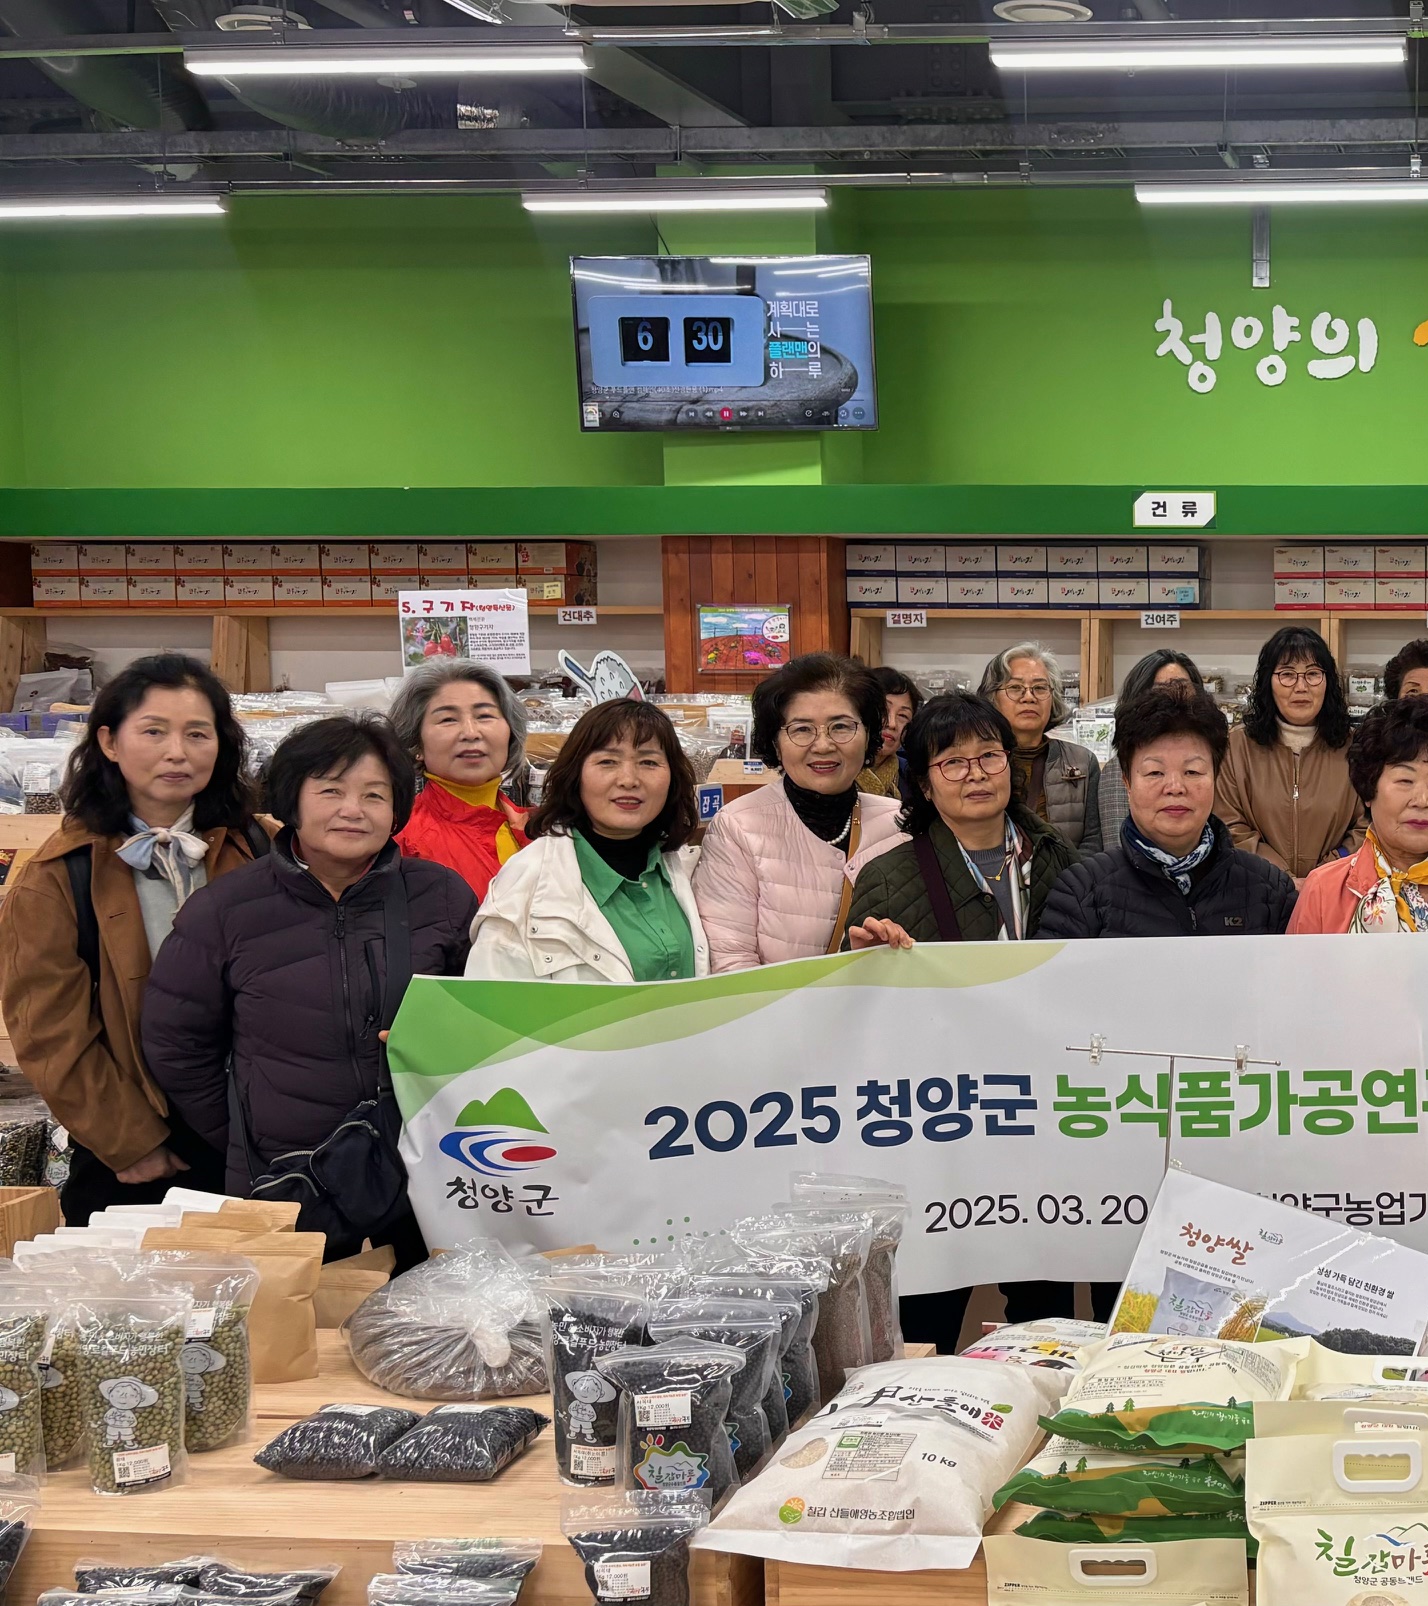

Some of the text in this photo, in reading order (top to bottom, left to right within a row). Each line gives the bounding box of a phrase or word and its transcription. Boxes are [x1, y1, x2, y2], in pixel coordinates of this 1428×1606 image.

[767, 301, 819, 318] 계획대로
[637, 321, 723, 350] 6 30
[768, 341, 820, 359] 플랜맨의
[1154, 300, 1378, 393] 청양의
[402, 601, 416, 614] 5.
[562, 610, 594, 622] 건대추
[891, 612, 924, 625] 결명자
[1144, 613, 1178, 626] 건여주
[702, 794, 720, 813] 잡곡
[1224, 916, 1243, 927] K2
[645, 1085, 841, 1161] 2025
[857, 1074, 1037, 1148] 청양군
[445, 1175, 560, 1217] 청양군
[1179, 1222, 1255, 1266] 청양쌀
[1332, 1271, 1347, 1284] 가득
[1348, 1276, 1363, 1289] 담긴
[1363, 1282, 1386, 1297] 친환경
[1386, 1290, 1395, 1300] 쌀
[921, 1452, 957, 1467] 10 kg
[648, 1463, 696, 1484] 칠갑마루
[807, 1506, 915, 1521] 칠갑 산들애영농조합법인
[1353, 1575, 1378, 1586] 청양군
